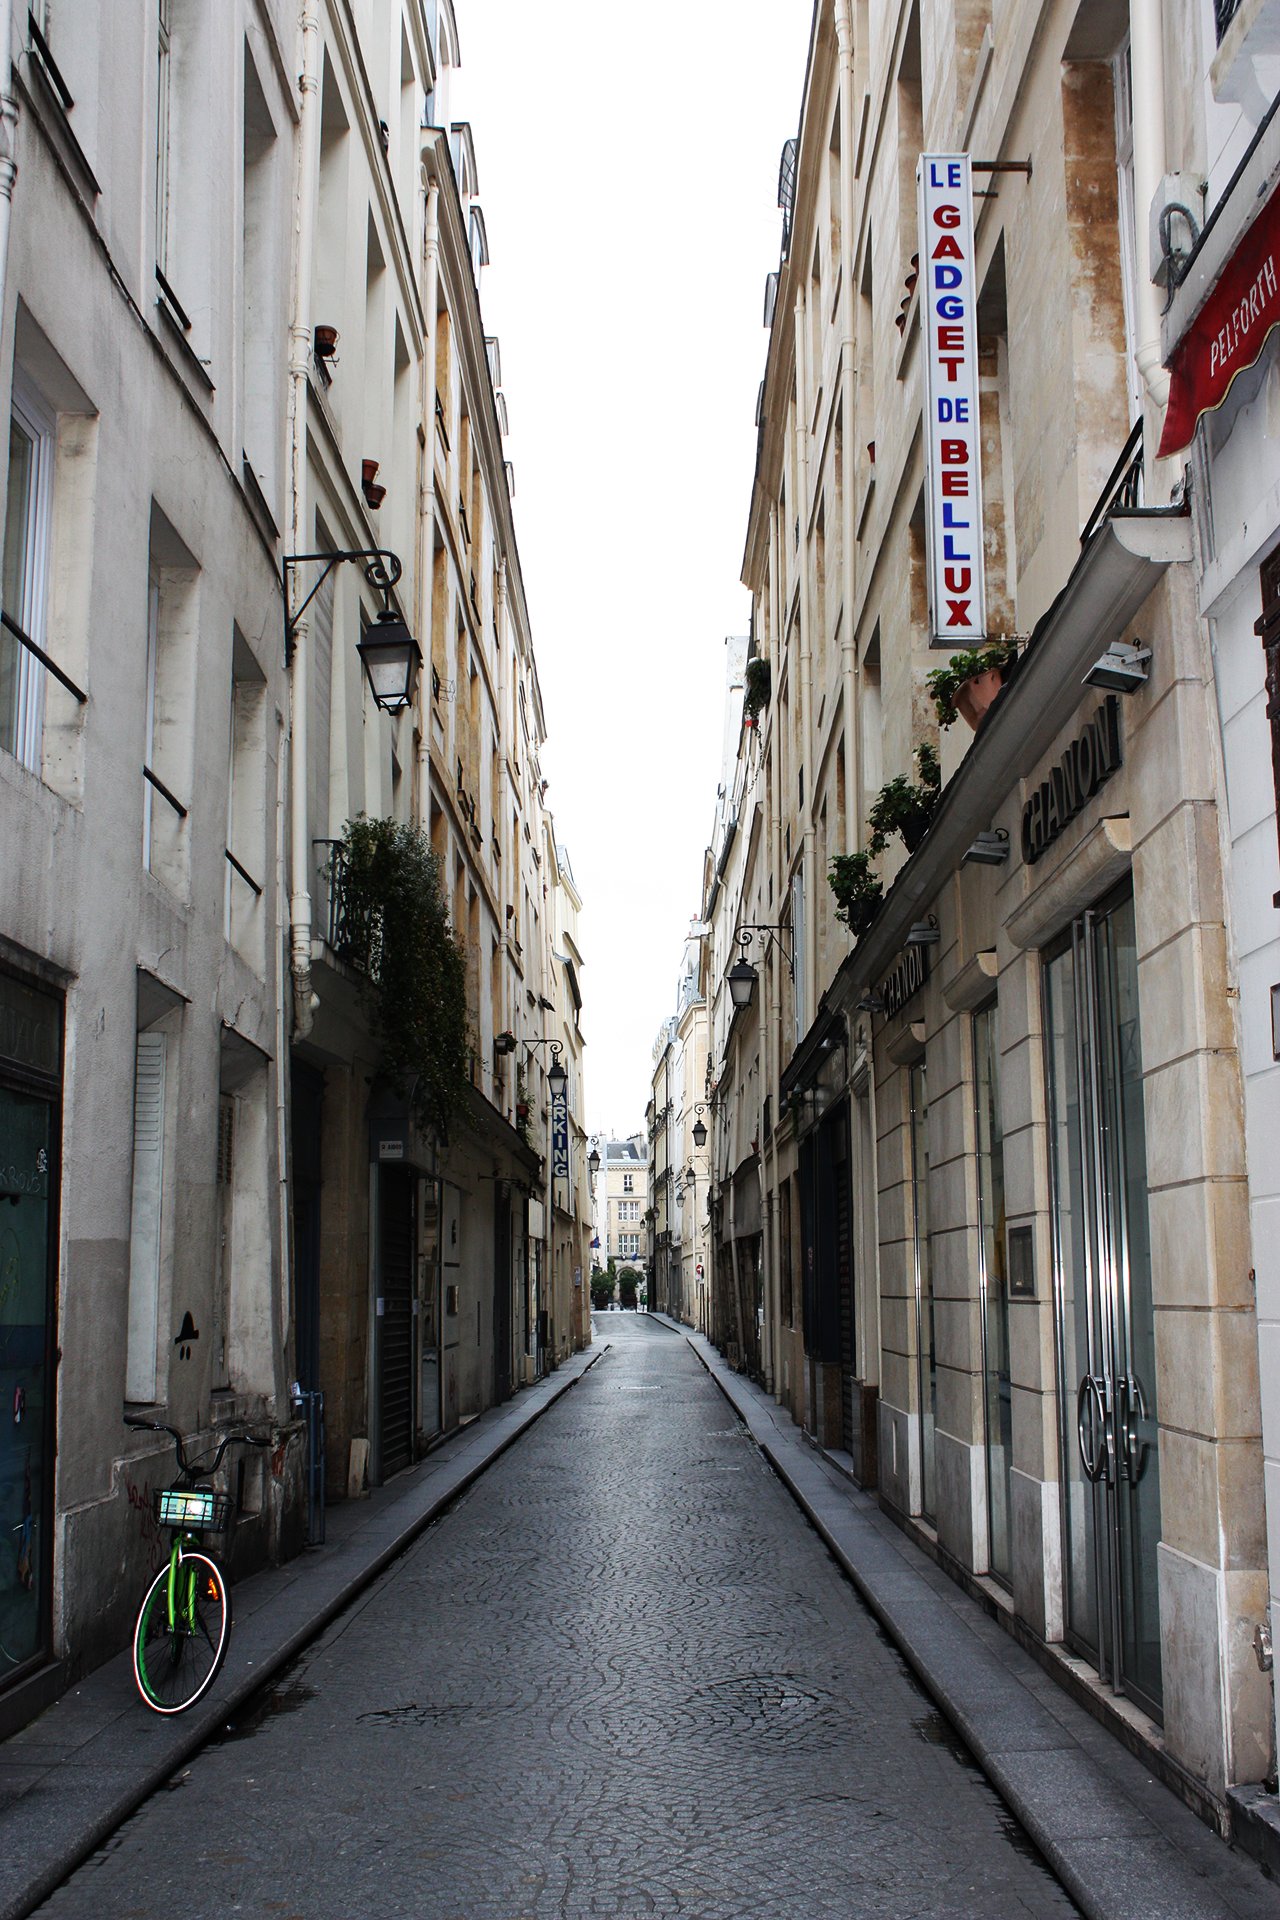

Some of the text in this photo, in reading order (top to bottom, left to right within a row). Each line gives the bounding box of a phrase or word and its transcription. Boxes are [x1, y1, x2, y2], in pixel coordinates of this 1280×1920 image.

[1209, 254, 1278, 378] PELFORTH
[930, 163, 973, 627] LE GADGET DE BELLUX
[1020, 694, 1122, 866] CHANON
[882, 944, 928, 1023] CHANON
[552, 1092, 568, 1178] ARKING
